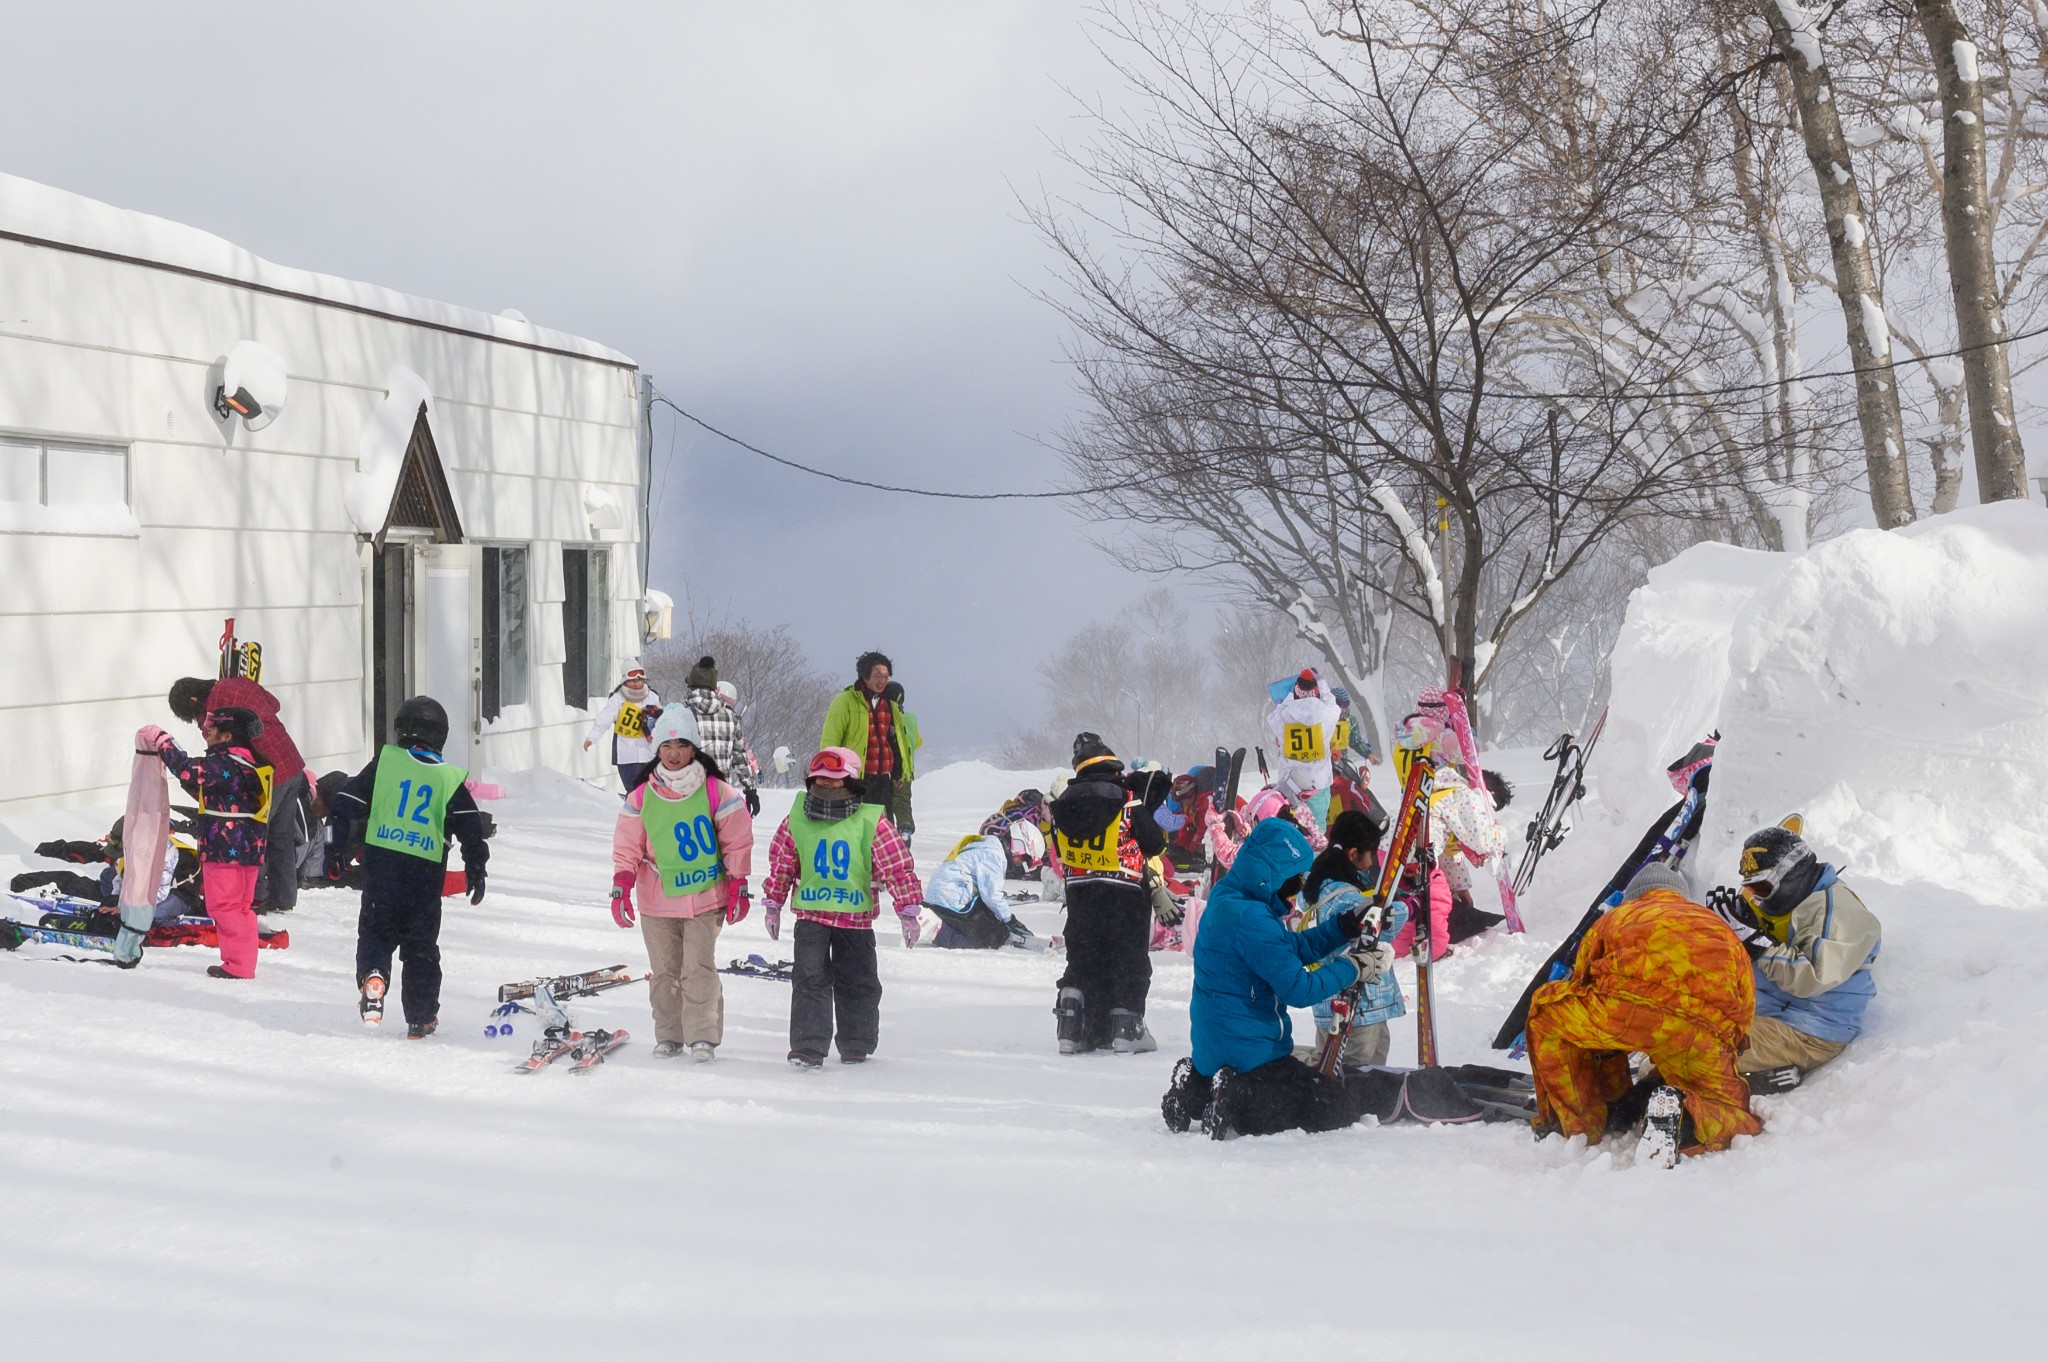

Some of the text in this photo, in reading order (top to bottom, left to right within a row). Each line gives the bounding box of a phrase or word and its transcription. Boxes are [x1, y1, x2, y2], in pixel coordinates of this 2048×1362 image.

[1290, 728, 1313, 751] 51
[397, 779, 433, 825] 12
[377, 824, 434, 851] 山の手小
[674, 815, 716, 861] 80
[814, 839, 850, 880] 49
[1066, 850, 1110, 866] 奥沢小
[801, 887, 864, 905] 山の手小
